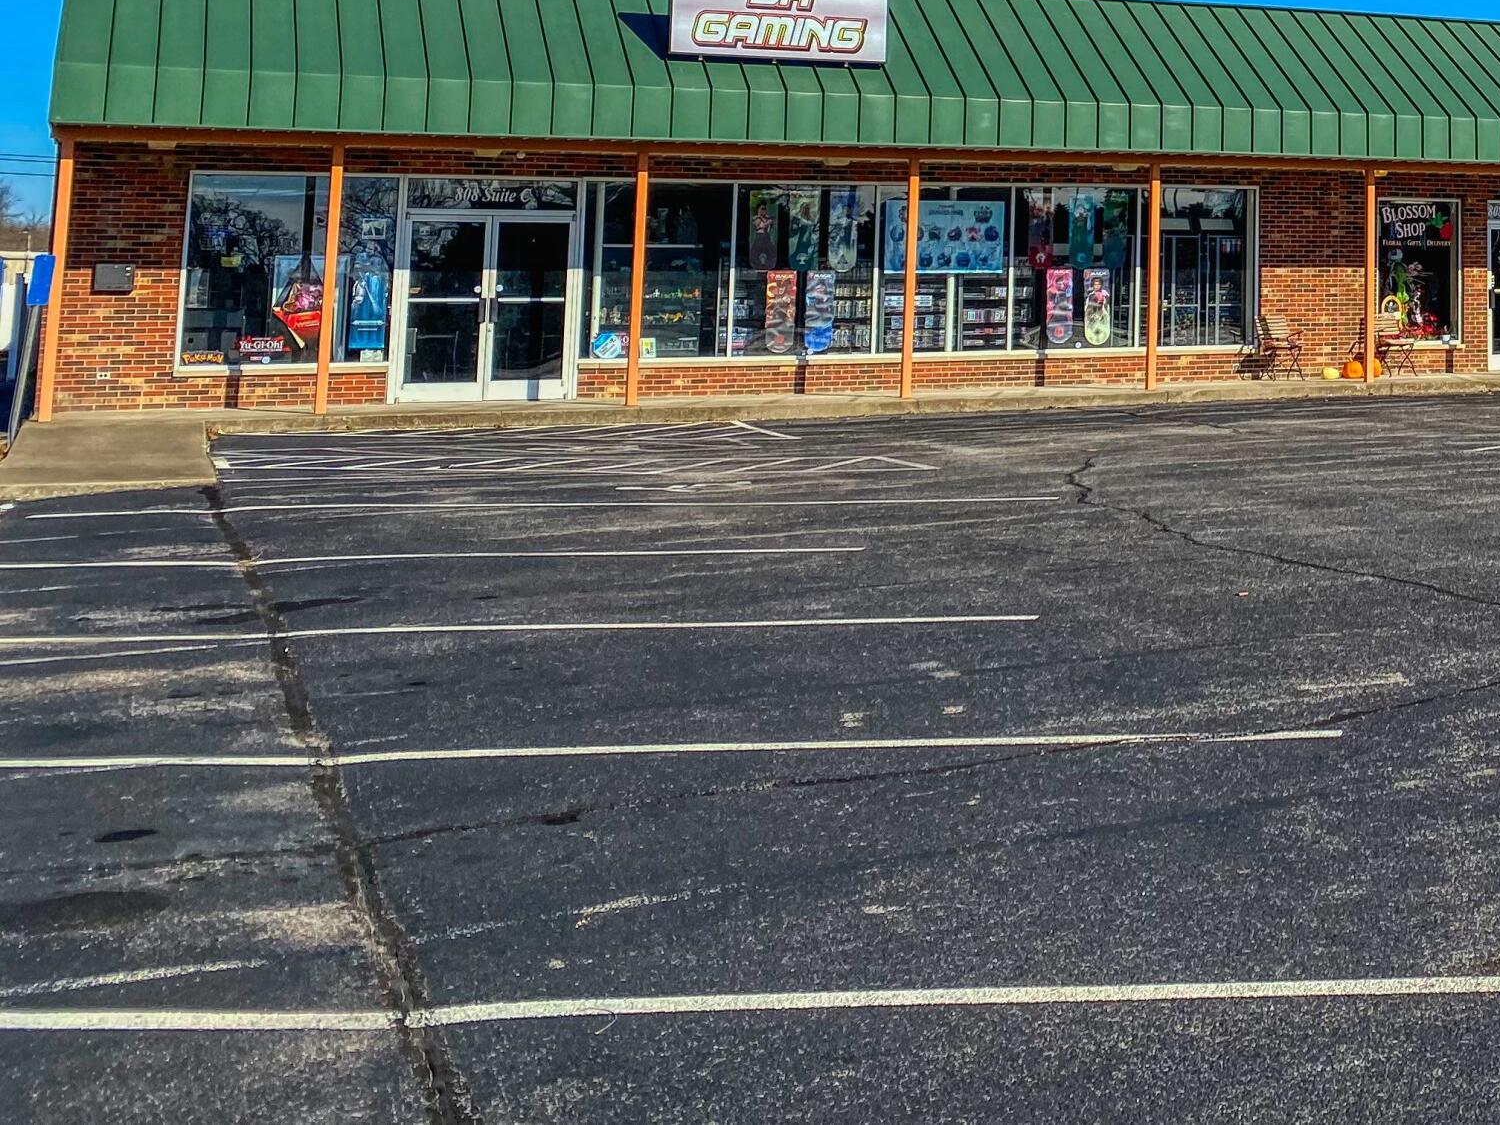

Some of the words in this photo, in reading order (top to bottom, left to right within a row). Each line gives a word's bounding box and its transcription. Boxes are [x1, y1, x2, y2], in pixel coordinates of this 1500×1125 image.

[691, 10, 868, 53] GAMING
[455, 188, 479, 201] 808
[481, 188, 516, 203] Suite
[520, 188, 532, 203] C
[1381, 205, 1436, 224] BLOSSOM
[1395, 222, 1426, 238] SHOP
